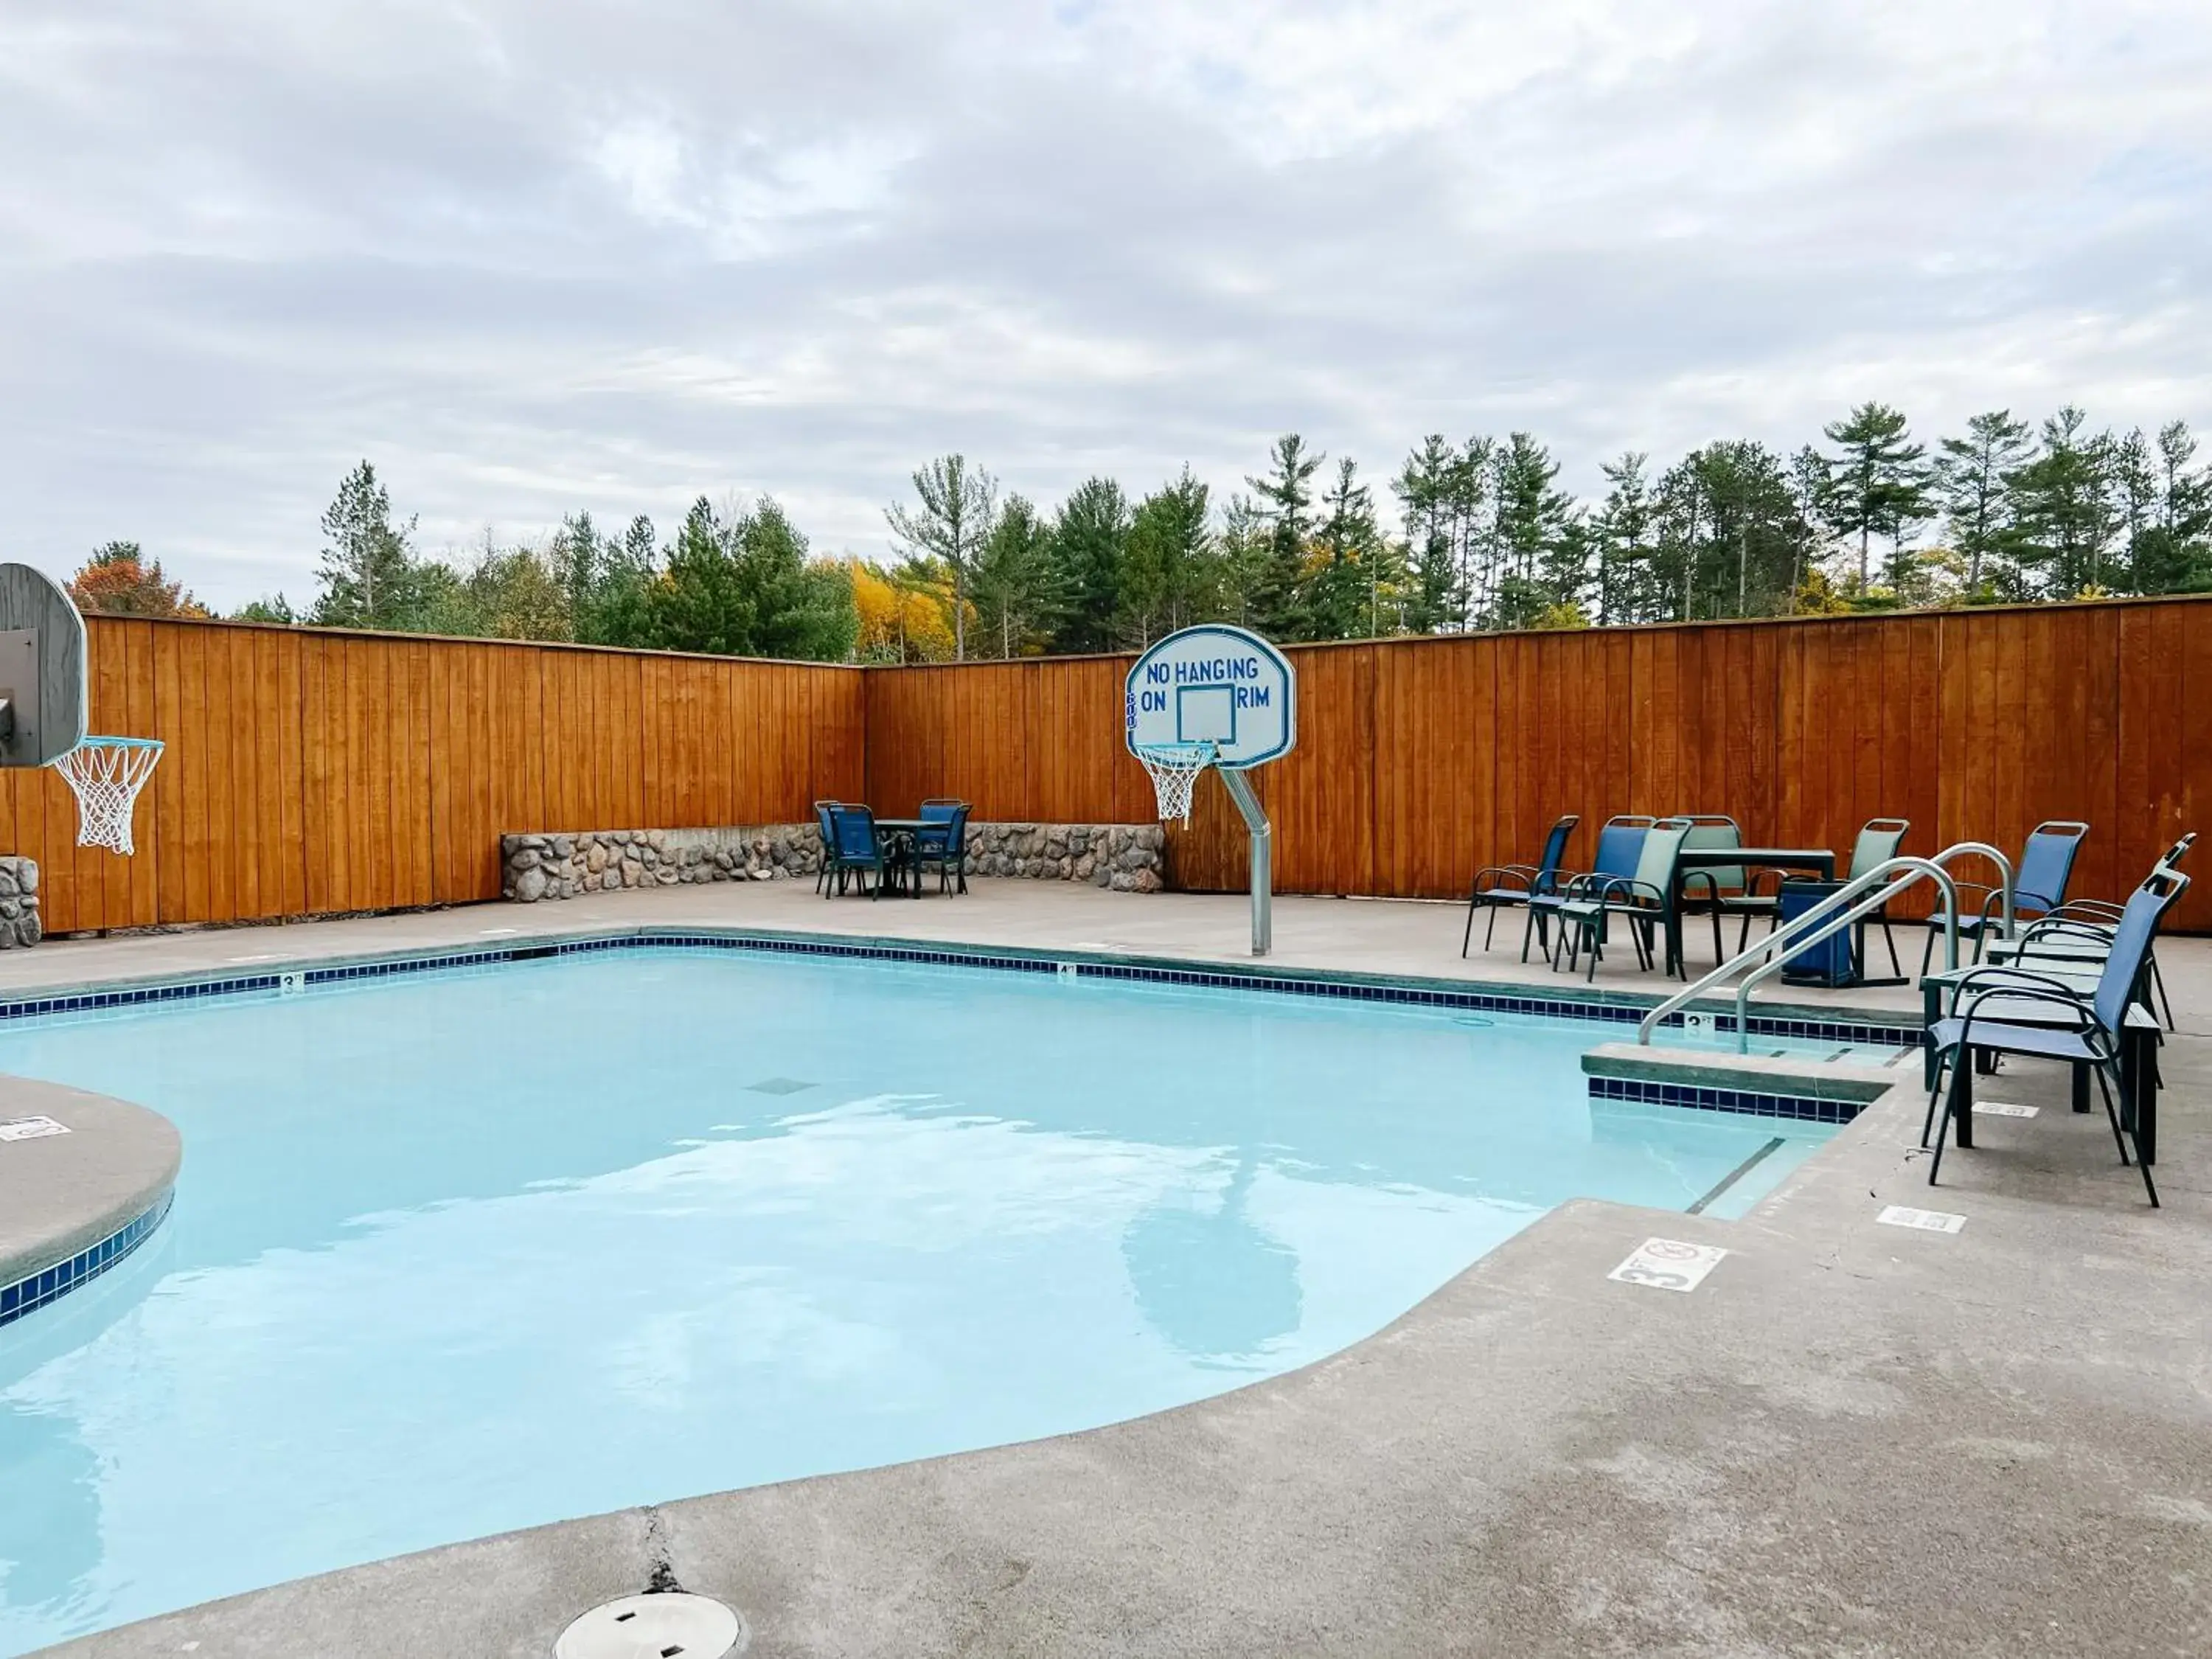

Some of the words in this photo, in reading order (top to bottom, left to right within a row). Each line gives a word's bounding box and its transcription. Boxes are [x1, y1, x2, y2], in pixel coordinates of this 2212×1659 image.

[1147, 663, 1169, 684] NO
[1175, 658, 1258, 683] HANGING
[1141, 691, 1165, 712] ON
[1237, 686, 1269, 708] RIM
[1620, 1268, 1689, 1287] 3
